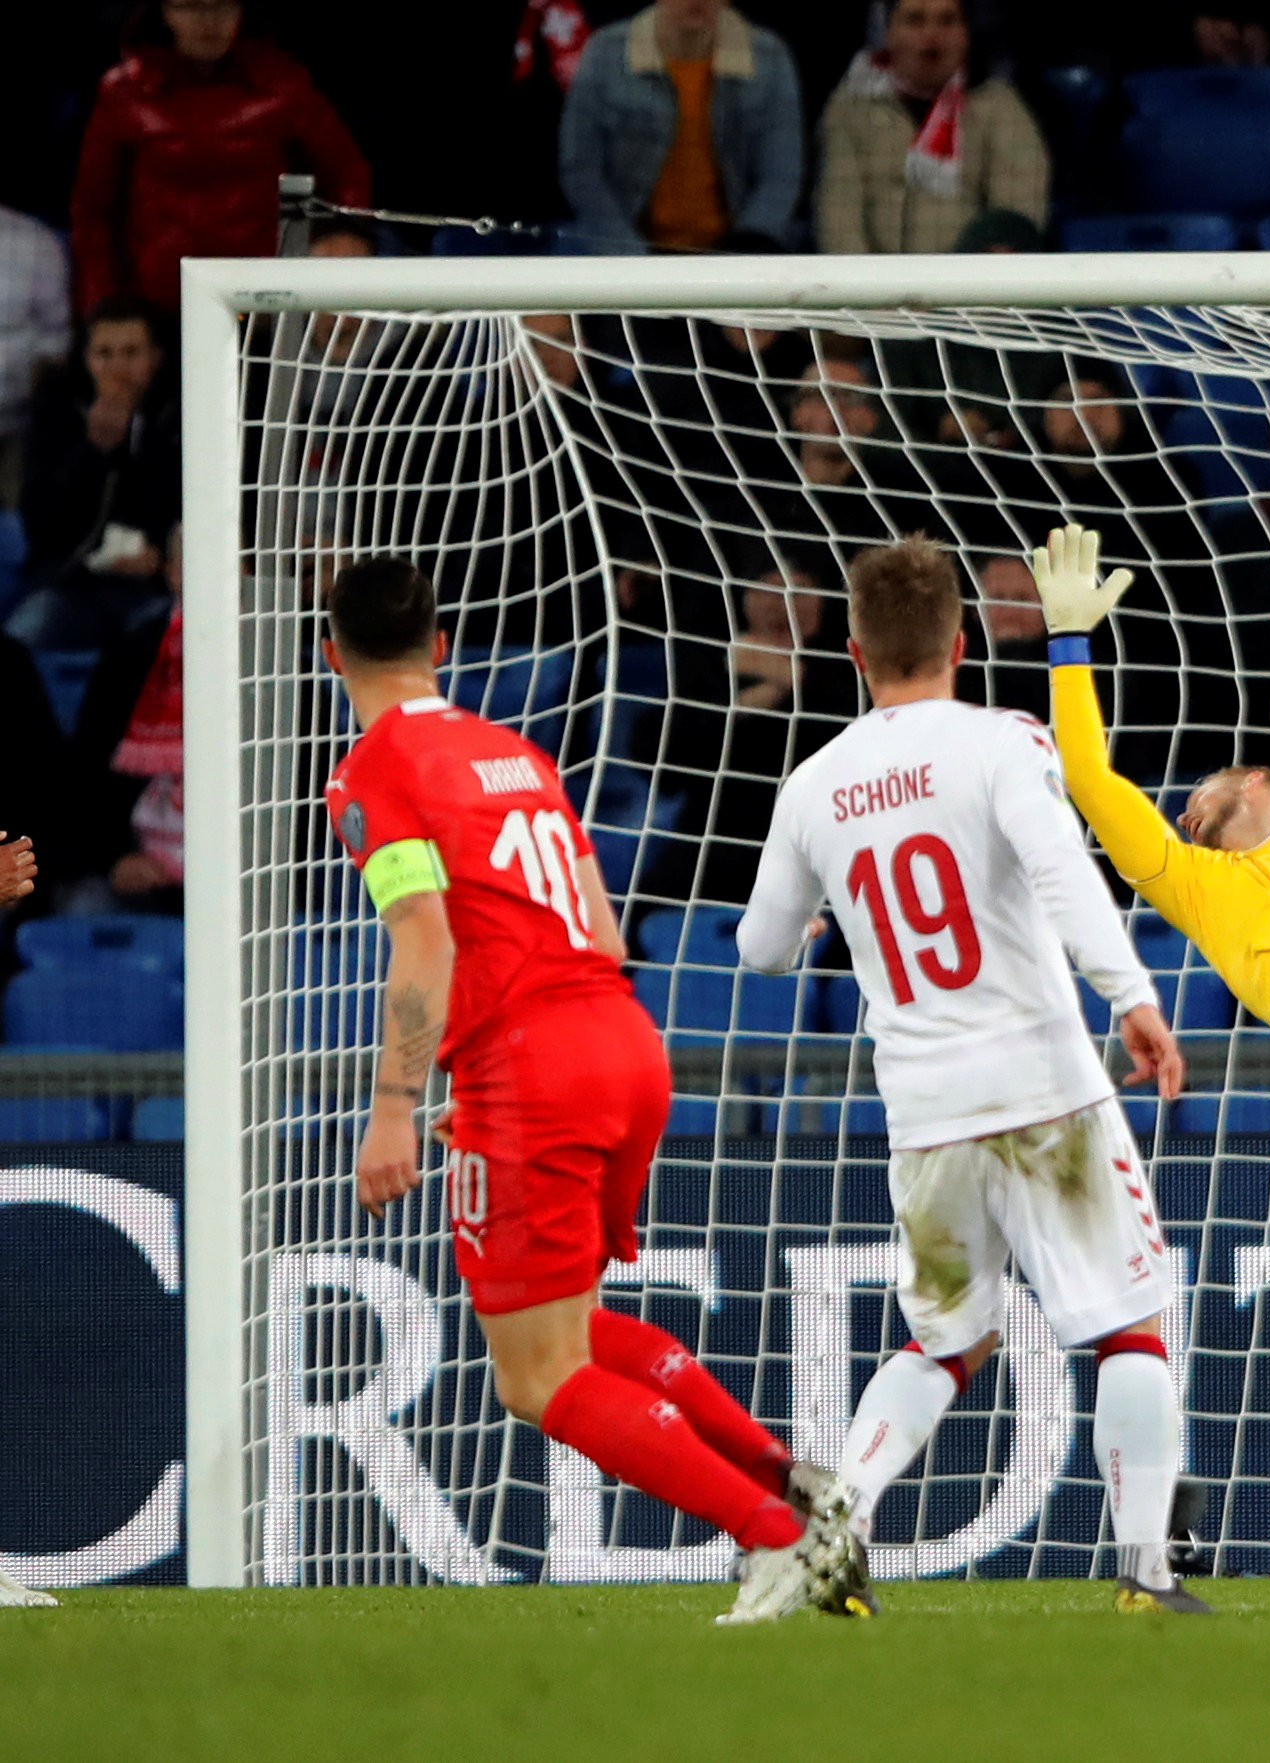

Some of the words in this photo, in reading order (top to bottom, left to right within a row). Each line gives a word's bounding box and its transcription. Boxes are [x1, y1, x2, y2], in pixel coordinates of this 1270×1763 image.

[832, 764, 934, 823] SCHÖNE
[490, 809, 592, 949] 10
[846, 833, 982, 1006] 19
[448, 1148, 487, 1224] 10
